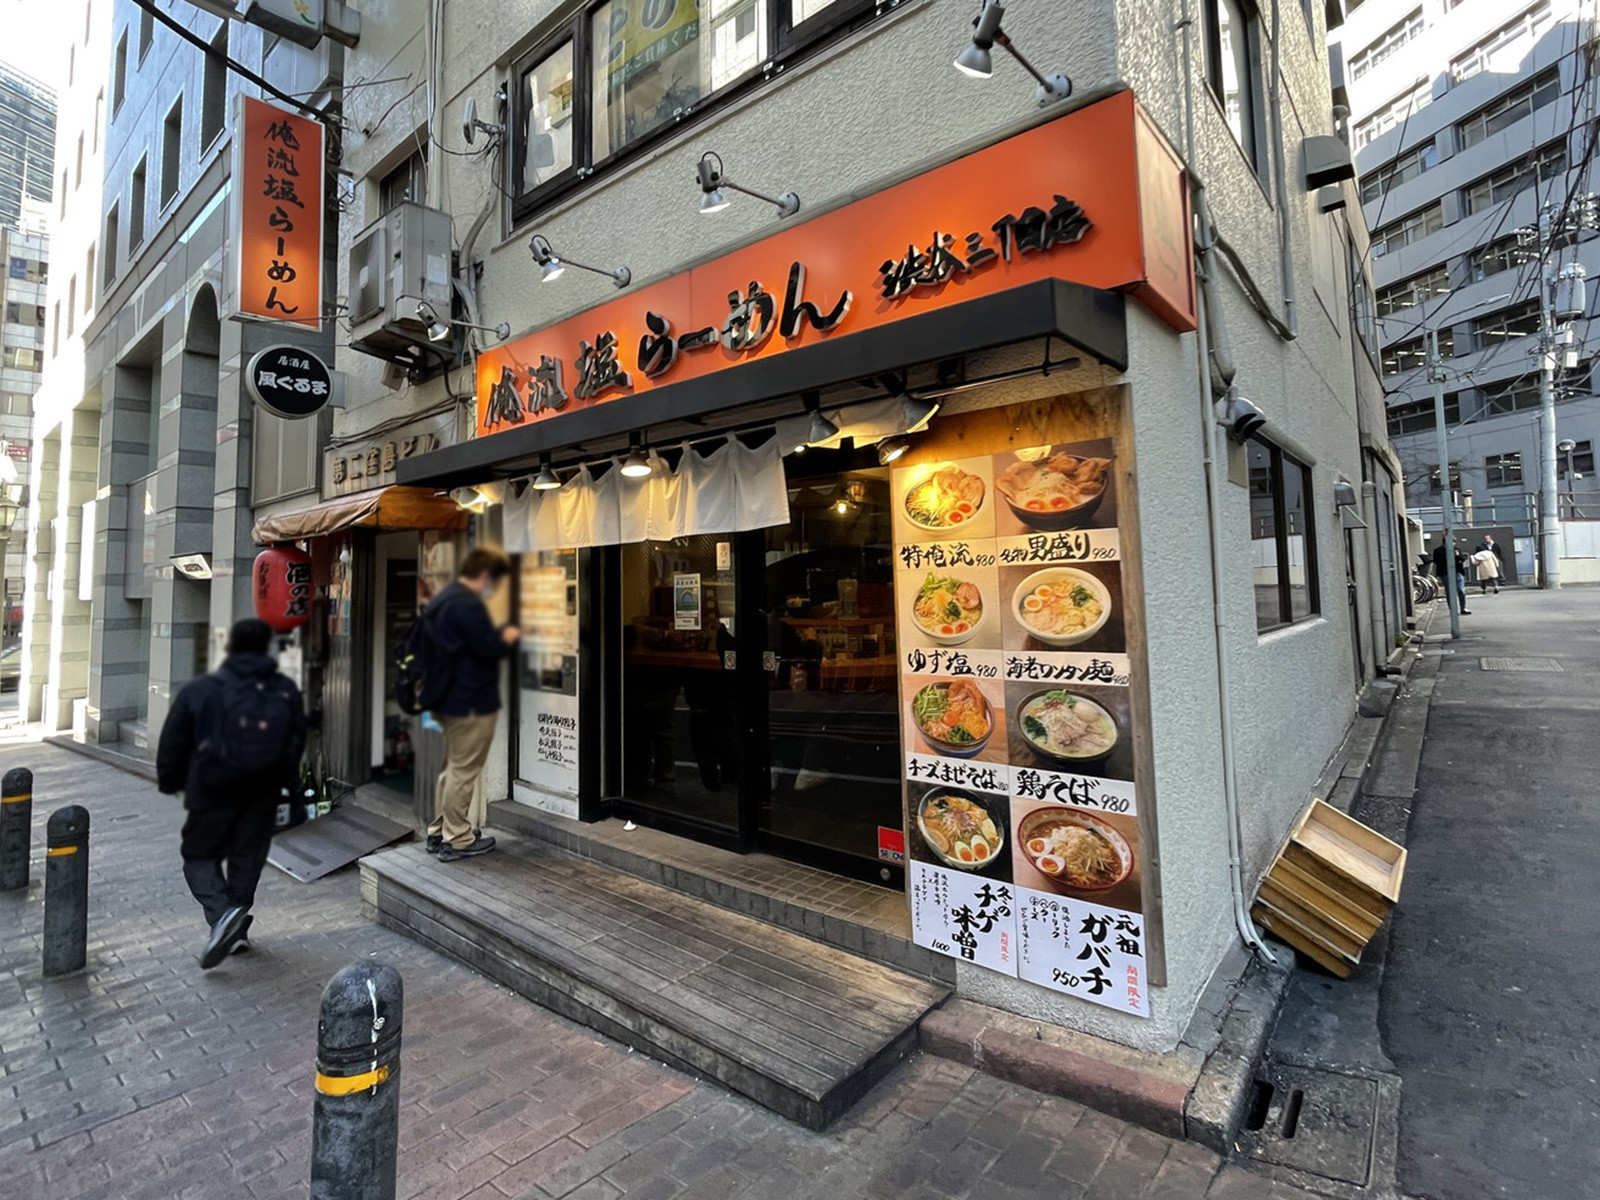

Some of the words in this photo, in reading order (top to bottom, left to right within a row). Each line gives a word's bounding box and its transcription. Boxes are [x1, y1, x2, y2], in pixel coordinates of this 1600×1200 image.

[263, 120, 305, 315] 俺流塩らーめん
[484, 261, 853, 428] 俺流塩らーめん
[879, 194, 1094, 299] 渋谷三丁目店
[277, 355, 310, 371] 居酒屋
[258, 370, 328, 396] 風ぐるま
[900, 542, 975, 569] 特俺流
[975, 554, 995, 567] 980
[1092, 547, 1116, 560] 980
[907, 648, 976, 676] ゆず塩
[976, 664, 998, 678] 980
[1005, 655, 1114, 684] 海老ワンタン麺
[908, 758, 999, 790] チーズまぜそば
[1016, 769, 1101, 806] 鶏そば
[1100, 794, 1130, 813] 980
[974, 882, 999, 933] チゲ
[996, 885, 1013, 917] 冬の
[951, 904, 981, 961] 味噌
[1114, 914, 1143, 958] 元祖
[1076, 912, 1115, 996] ガバチ
[1053, 967, 1080, 988] 950
